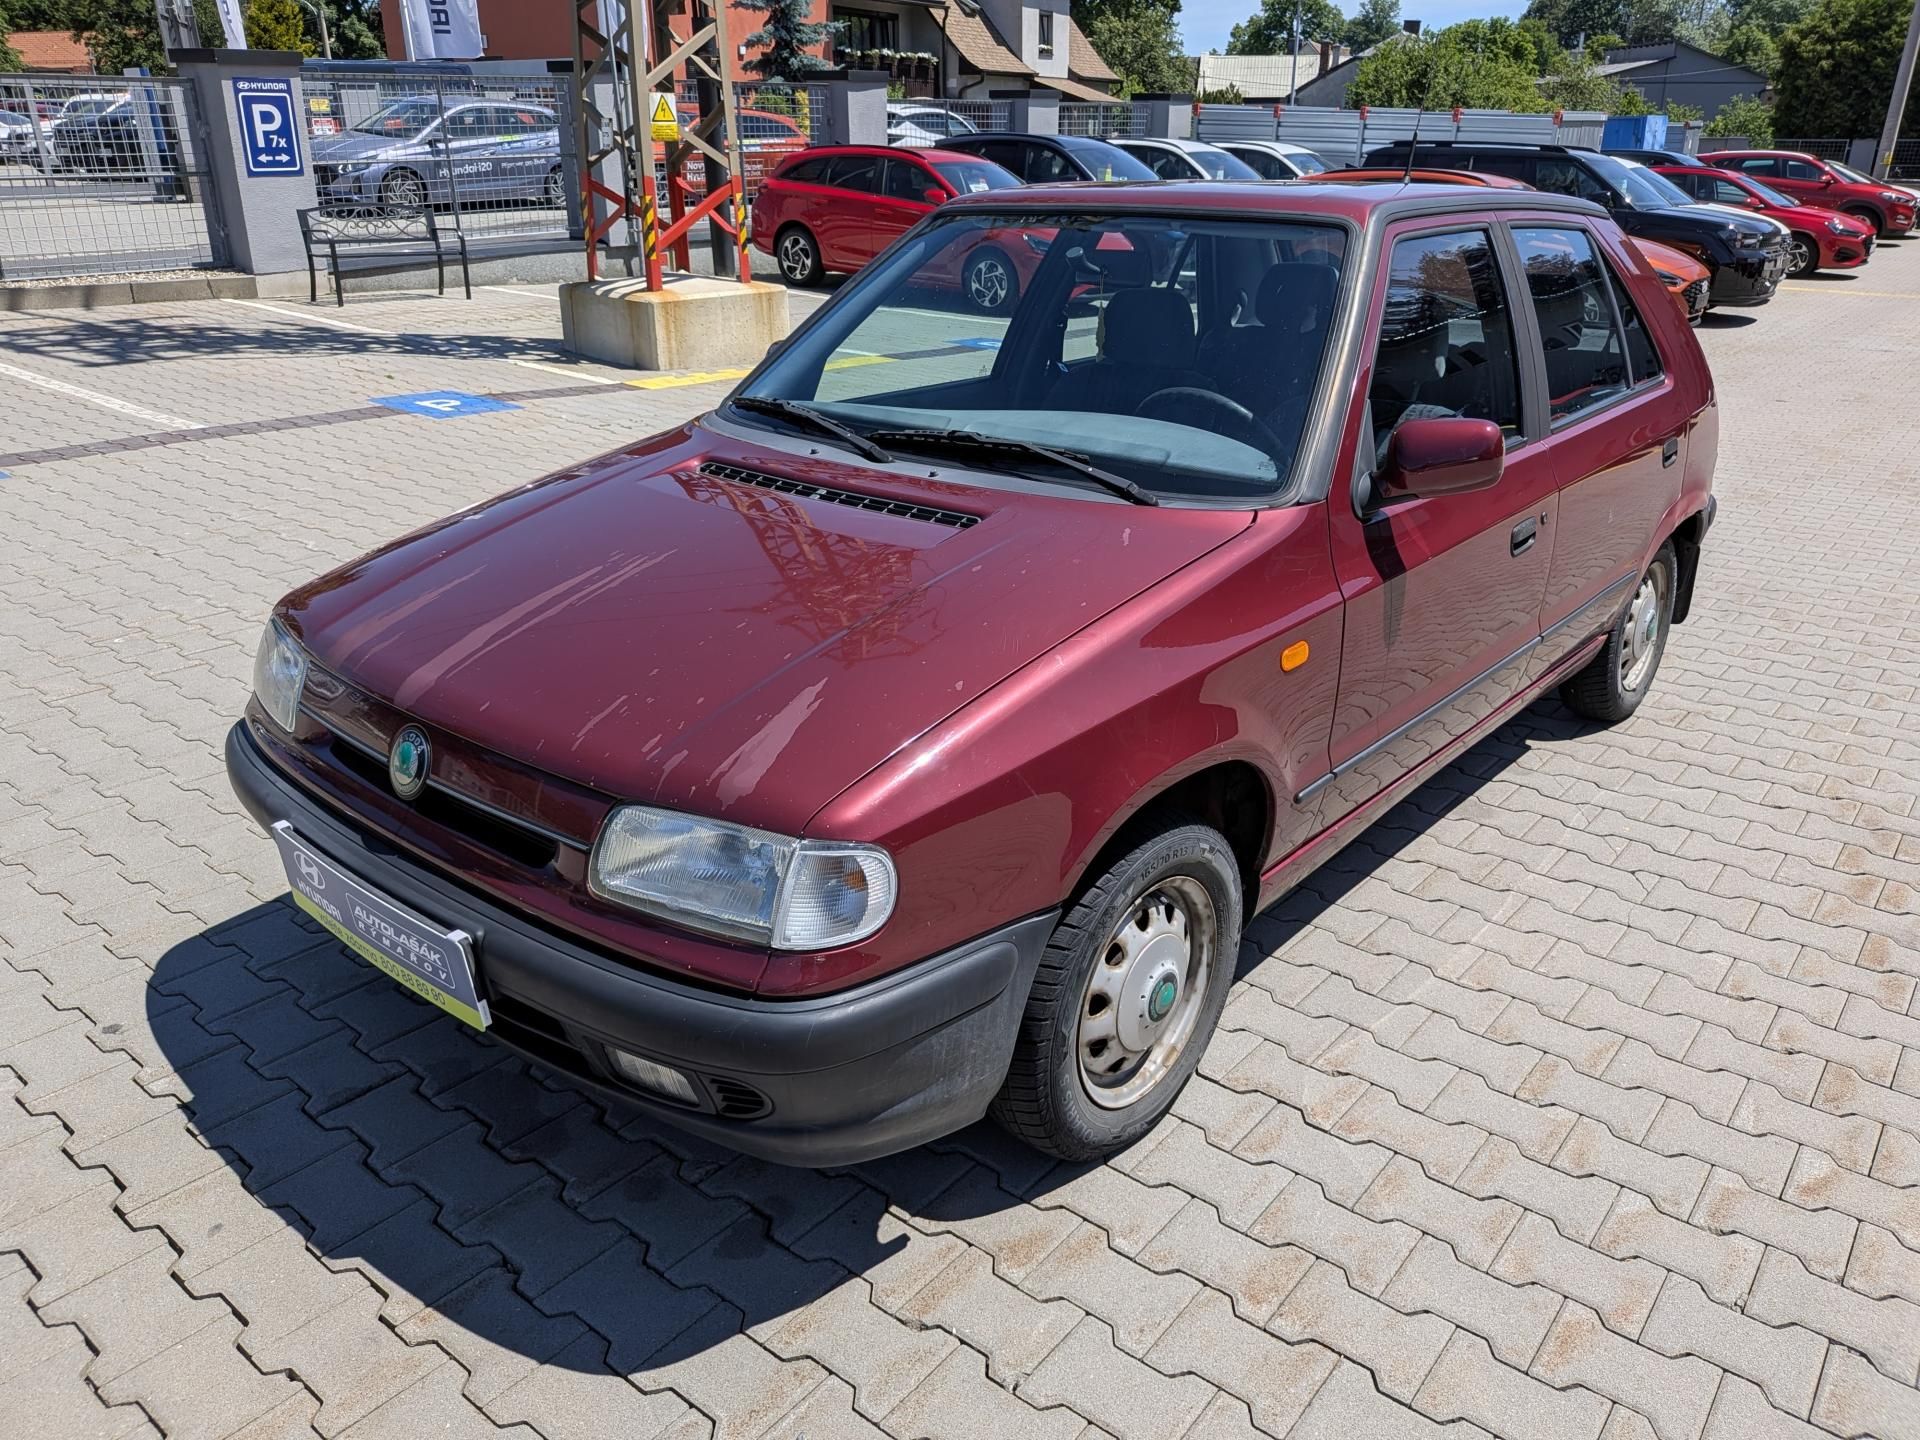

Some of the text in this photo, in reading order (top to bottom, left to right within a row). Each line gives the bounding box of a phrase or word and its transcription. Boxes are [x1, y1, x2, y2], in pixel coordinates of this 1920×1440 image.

[250, 82, 288, 90] HYUNDAI
[252, 103, 282, 148] P
[269, 135, 288, 148] 7x
[439, 161, 493, 178] Hyundai i20
[415, 399, 461, 411] P
[297, 878, 343, 922] HYUNDAI
[354, 906, 443, 966] AUTOLAŠÁK
[358, 921, 447, 980] RÝMAŘOV
[379, 955, 400, 978] 800
[430, 986, 446, 1006] 90
